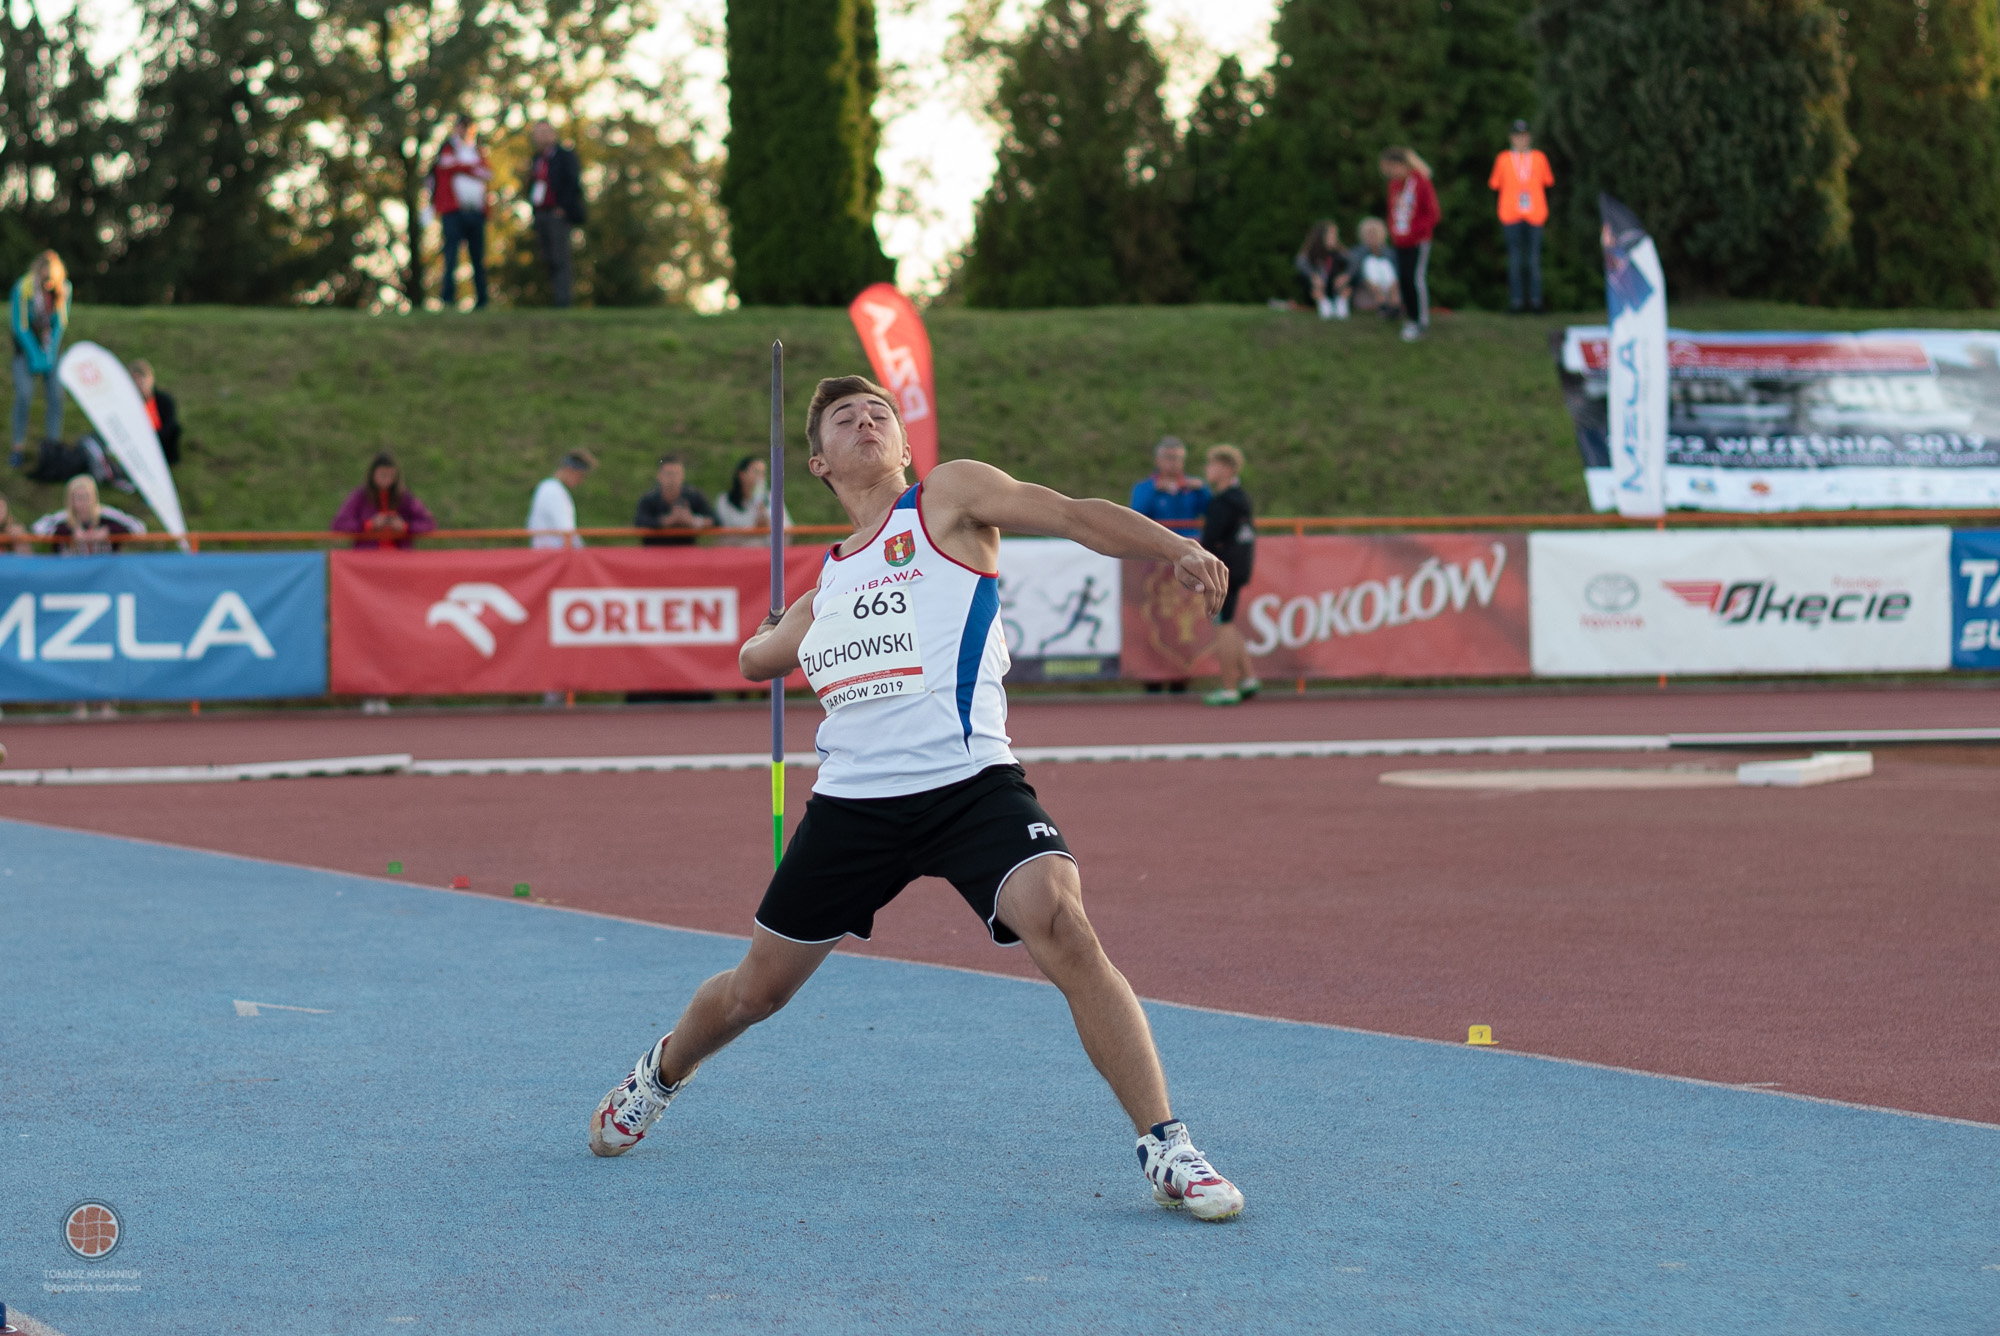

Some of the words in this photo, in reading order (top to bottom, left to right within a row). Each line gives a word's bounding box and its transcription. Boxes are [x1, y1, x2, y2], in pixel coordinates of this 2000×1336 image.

[853, 591, 907, 619] 663
[1245, 541, 1507, 656] SOKOŁÓW
[564, 599, 723, 635] ORLEN
[803, 632, 914, 678] ŻUCHOWSKI
[826, 686, 869, 710] TARNÓW
[872, 680, 904, 697] 2019
